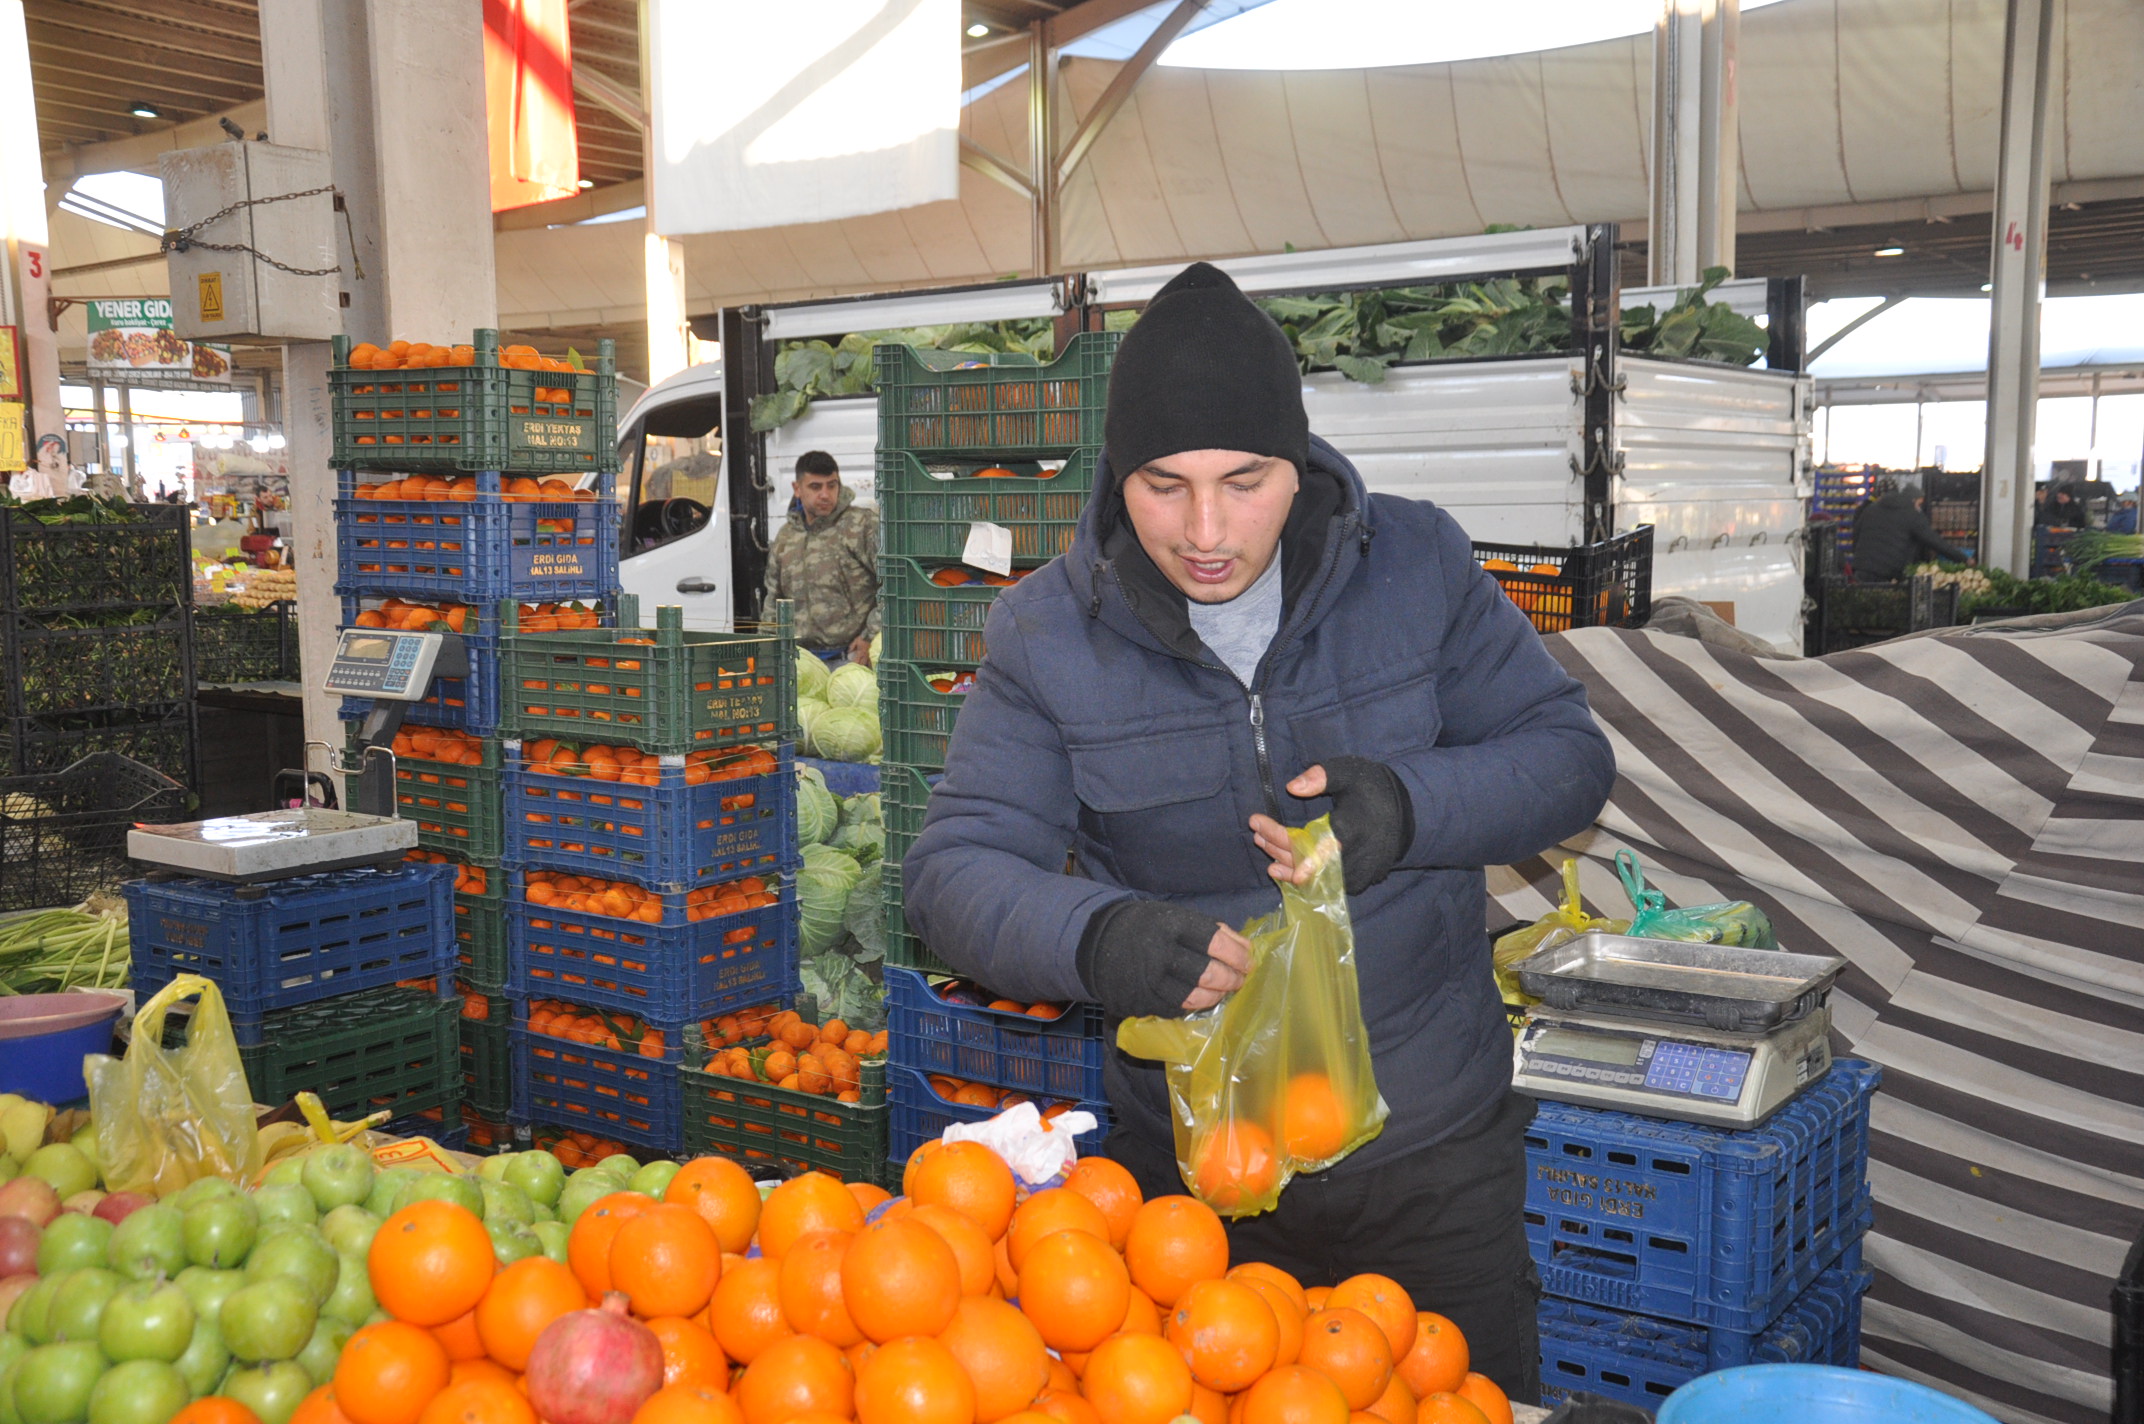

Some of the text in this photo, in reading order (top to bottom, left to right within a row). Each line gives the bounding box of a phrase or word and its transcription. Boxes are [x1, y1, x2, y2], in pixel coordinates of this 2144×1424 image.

[28, 250, 42, 278] 3
[95, 300, 143, 318] YENER
[556, 554, 578, 564] GIDA
[1546, 1186, 1593, 1209] GIDA
